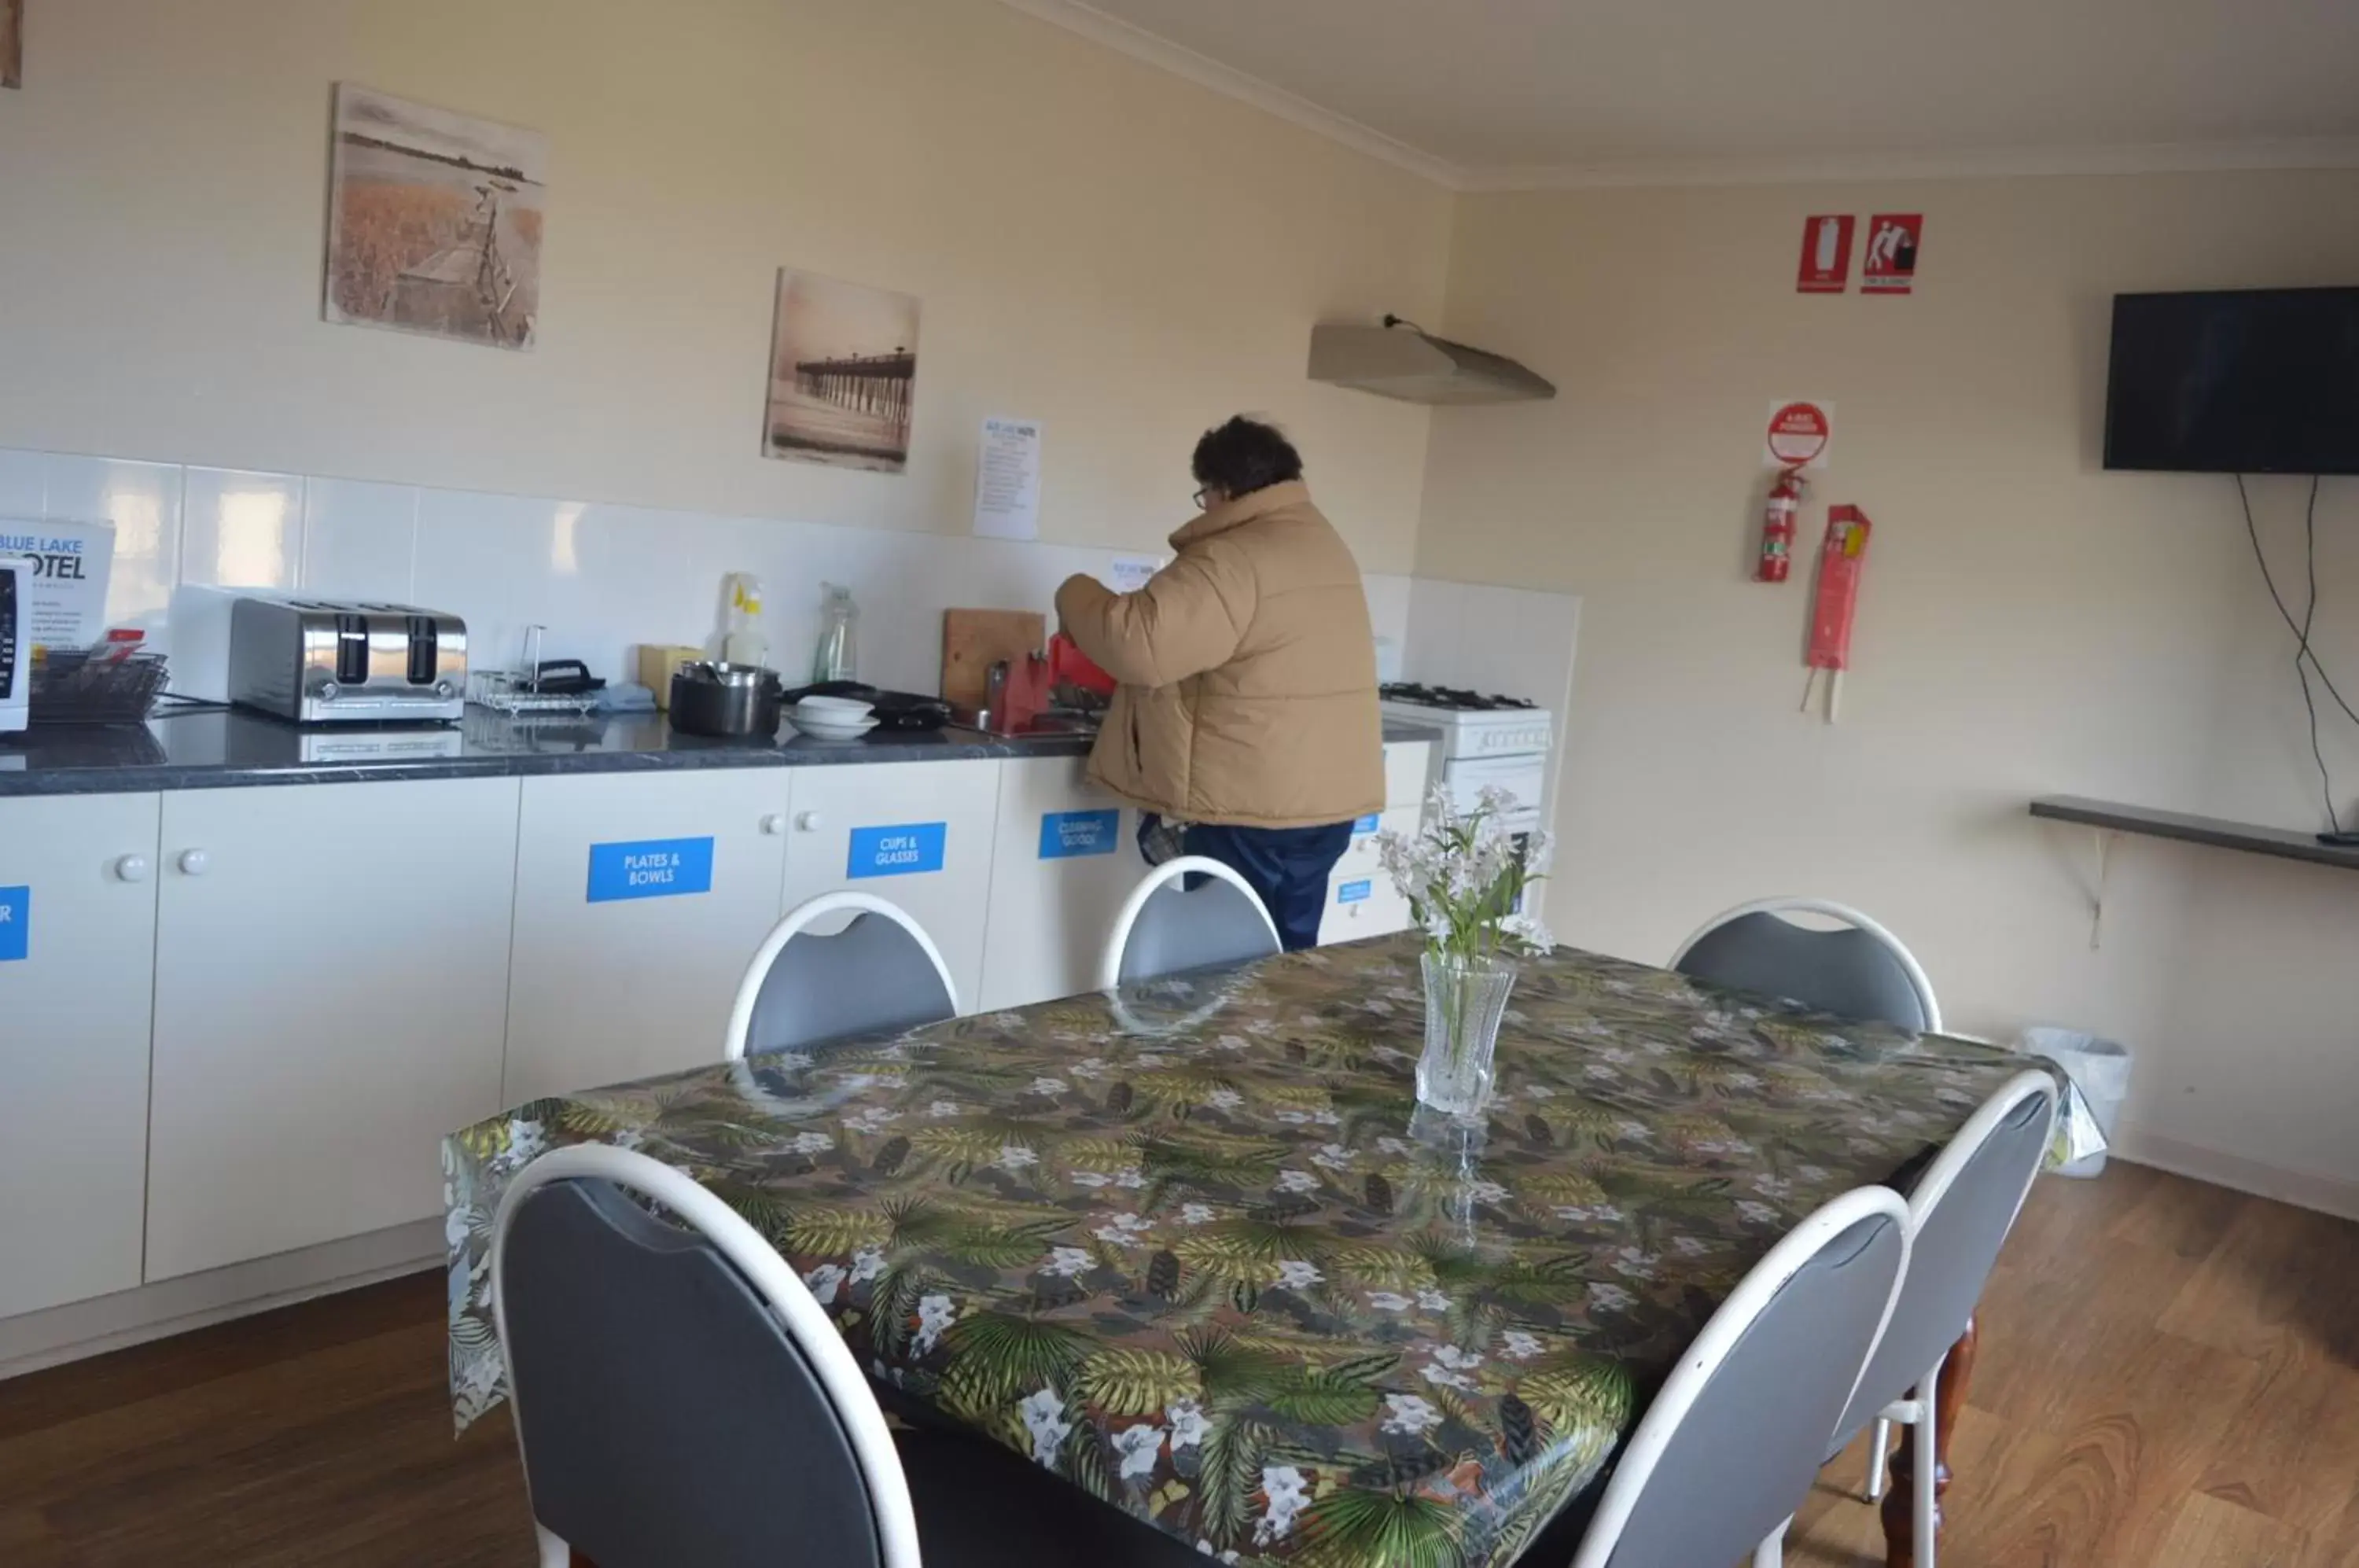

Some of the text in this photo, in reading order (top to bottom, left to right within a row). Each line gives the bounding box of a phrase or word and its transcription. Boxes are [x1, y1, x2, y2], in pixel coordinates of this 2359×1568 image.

[0, 535, 83, 554] BLUE LAKE
[8, 551, 85, 580] OTEL
[881, 837, 907, 851] CUPS
[624, 852, 680, 869] PLATES &
[875, 849, 918, 865] GLASSES
[629, 869, 675, 885] BOWLS
